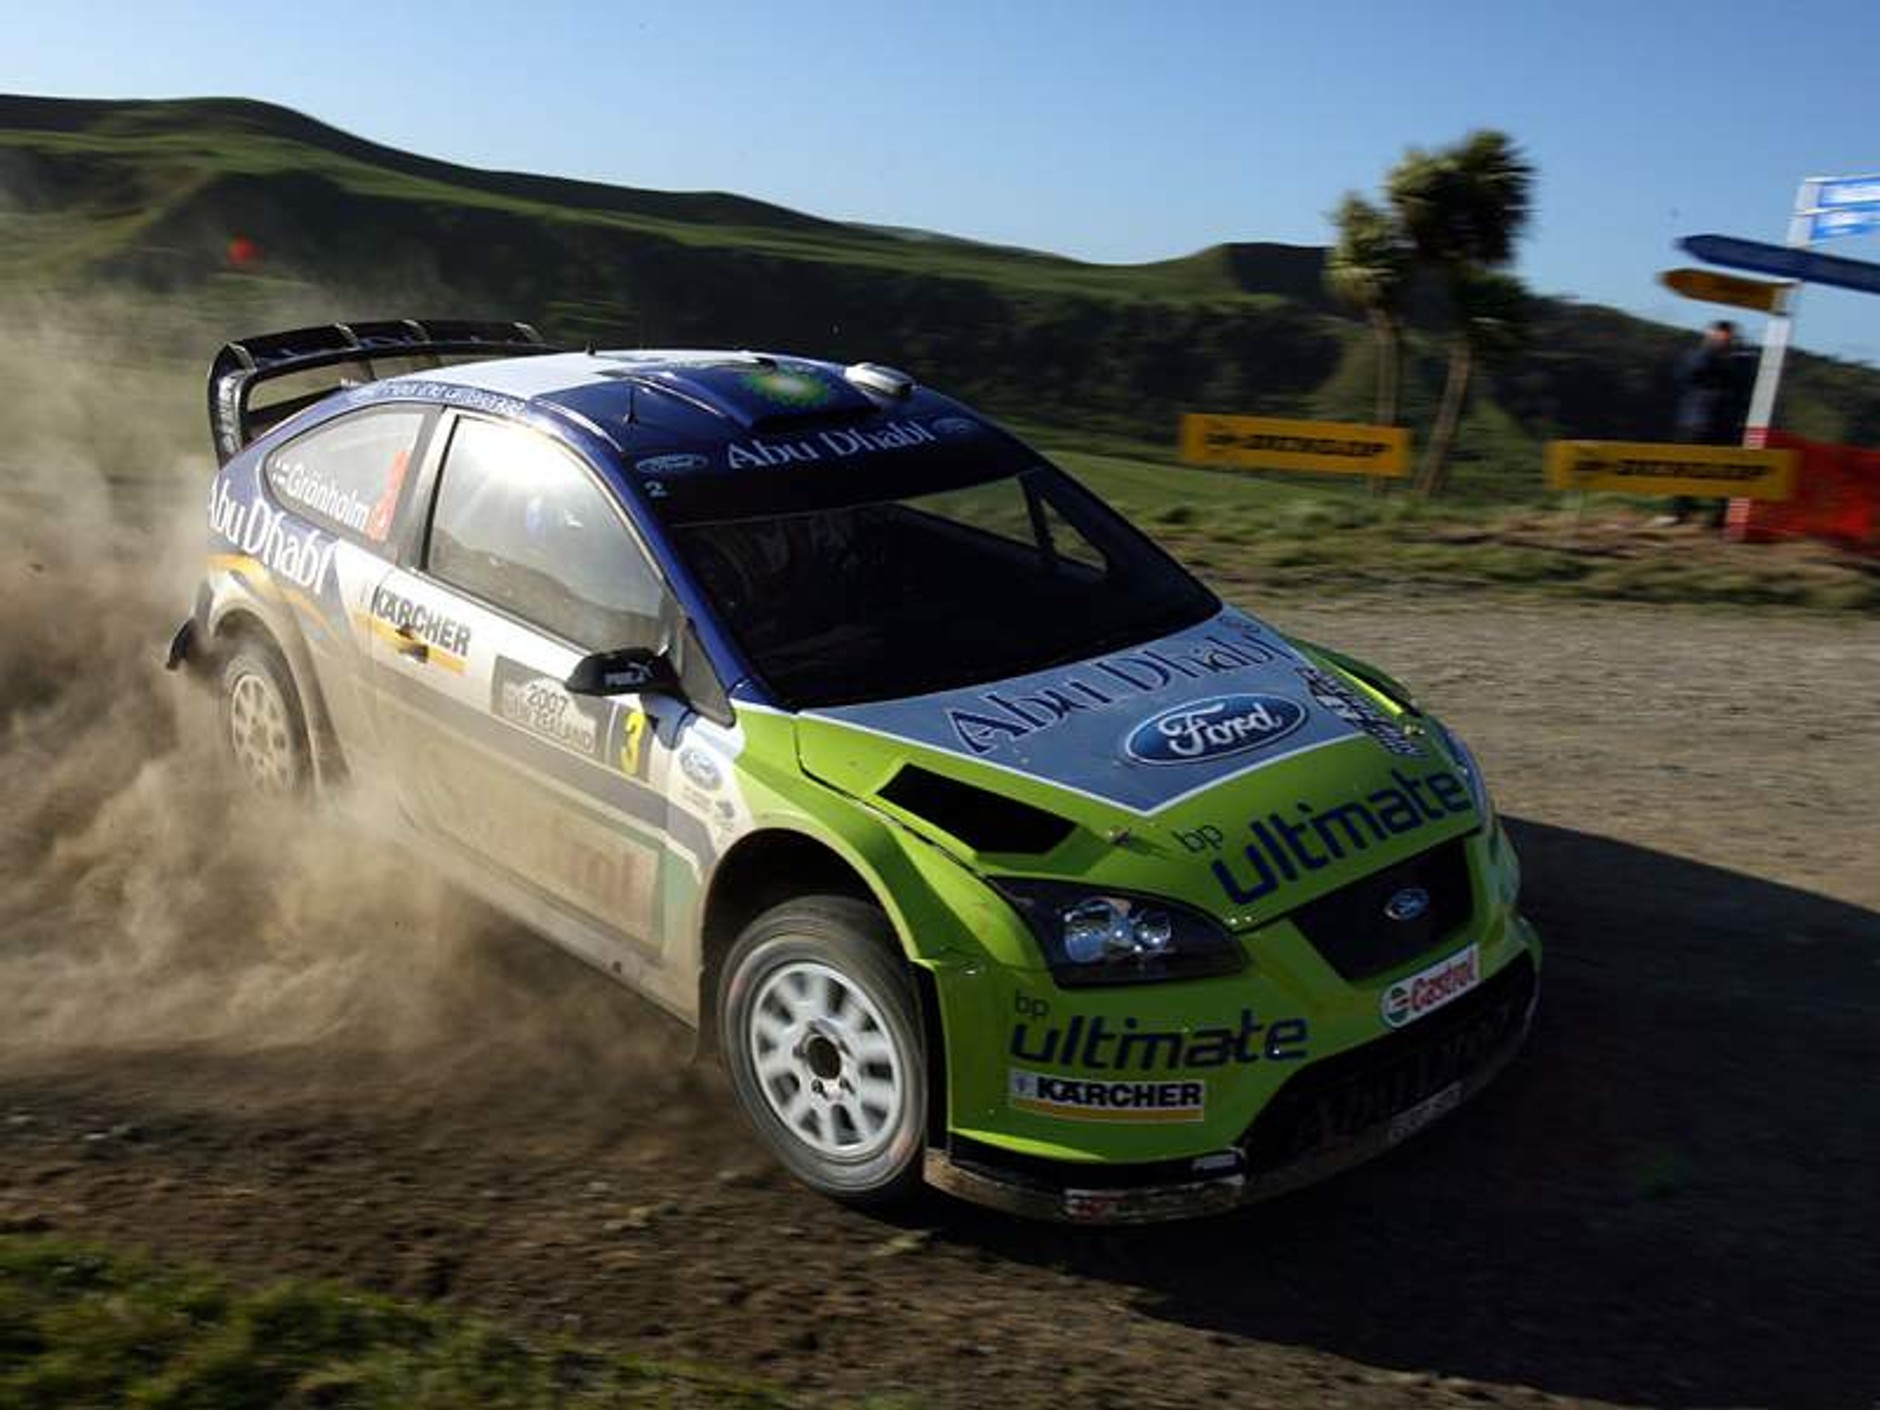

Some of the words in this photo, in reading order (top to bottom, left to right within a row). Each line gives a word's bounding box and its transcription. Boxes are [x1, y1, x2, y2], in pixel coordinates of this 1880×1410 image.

[728, 440, 820, 469] Abu
[820, 420, 936, 456] Dhabi
[242, 497, 336, 595] Dhabi
[947, 681, 1113, 754] Abu
[1095, 634, 1295, 692] Dhabi
[620, 711, 646, 776] 3
[1157, 702, 1284, 757] Ford
[1172, 825, 1225, 852] bp
[1211, 769, 1474, 906] ultimate
[1014, 989, 1050, 1017] bp
[1010, 1008, 1308, 1071] ultimate
